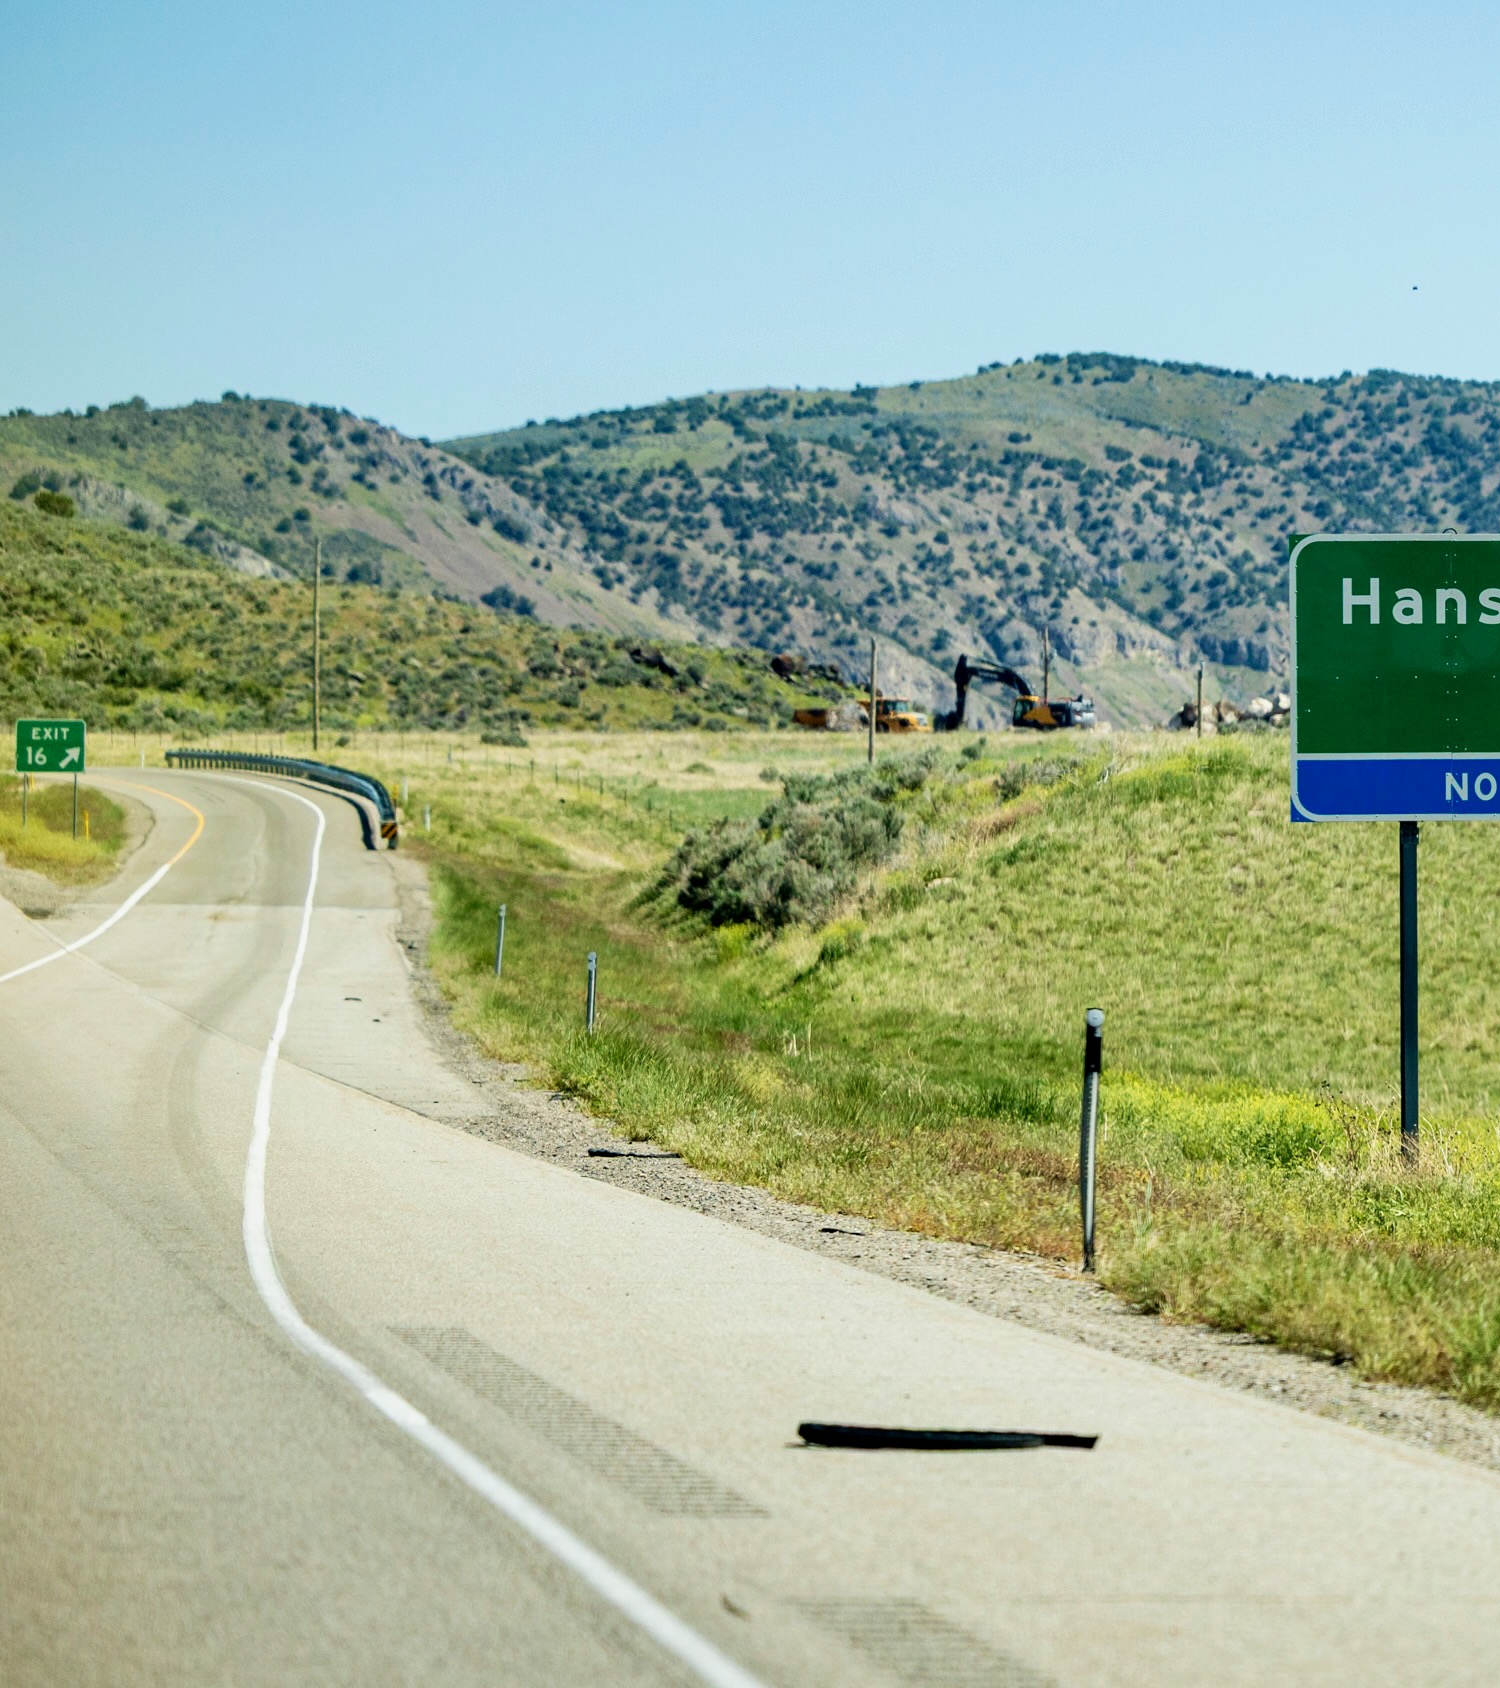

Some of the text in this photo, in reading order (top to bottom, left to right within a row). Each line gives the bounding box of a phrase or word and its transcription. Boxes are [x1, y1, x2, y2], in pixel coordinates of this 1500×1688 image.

[31, 727, 70, 740] EXIT
[26, 746, 47, 765] 16
[1445, 772, 1497, 801] NO
